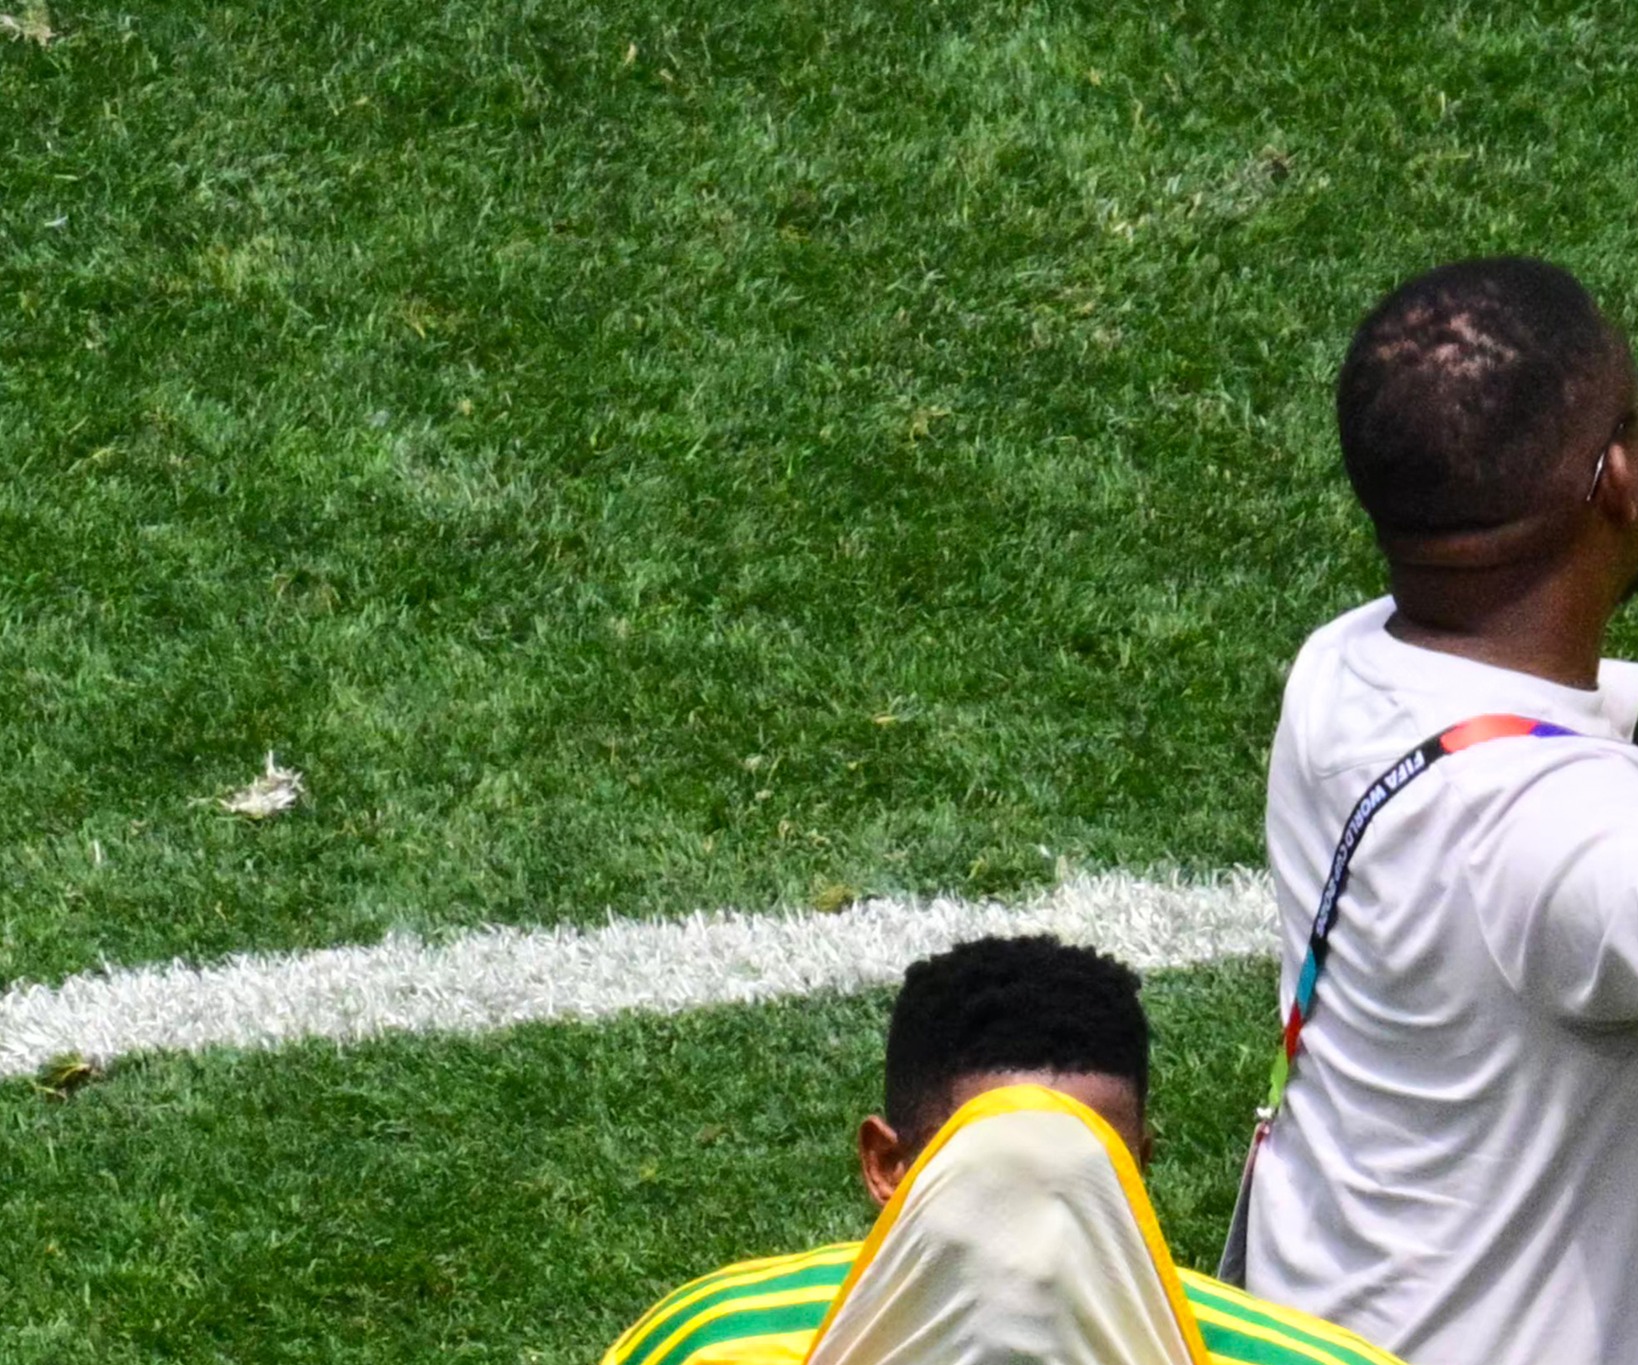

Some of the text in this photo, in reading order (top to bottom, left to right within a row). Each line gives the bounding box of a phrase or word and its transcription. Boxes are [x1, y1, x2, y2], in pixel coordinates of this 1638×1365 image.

[1384, 749, 1425, 790] FIFA
[1344, 783, 1387, 847] WORLD
[1333, 843, 1348, 881] CUP
